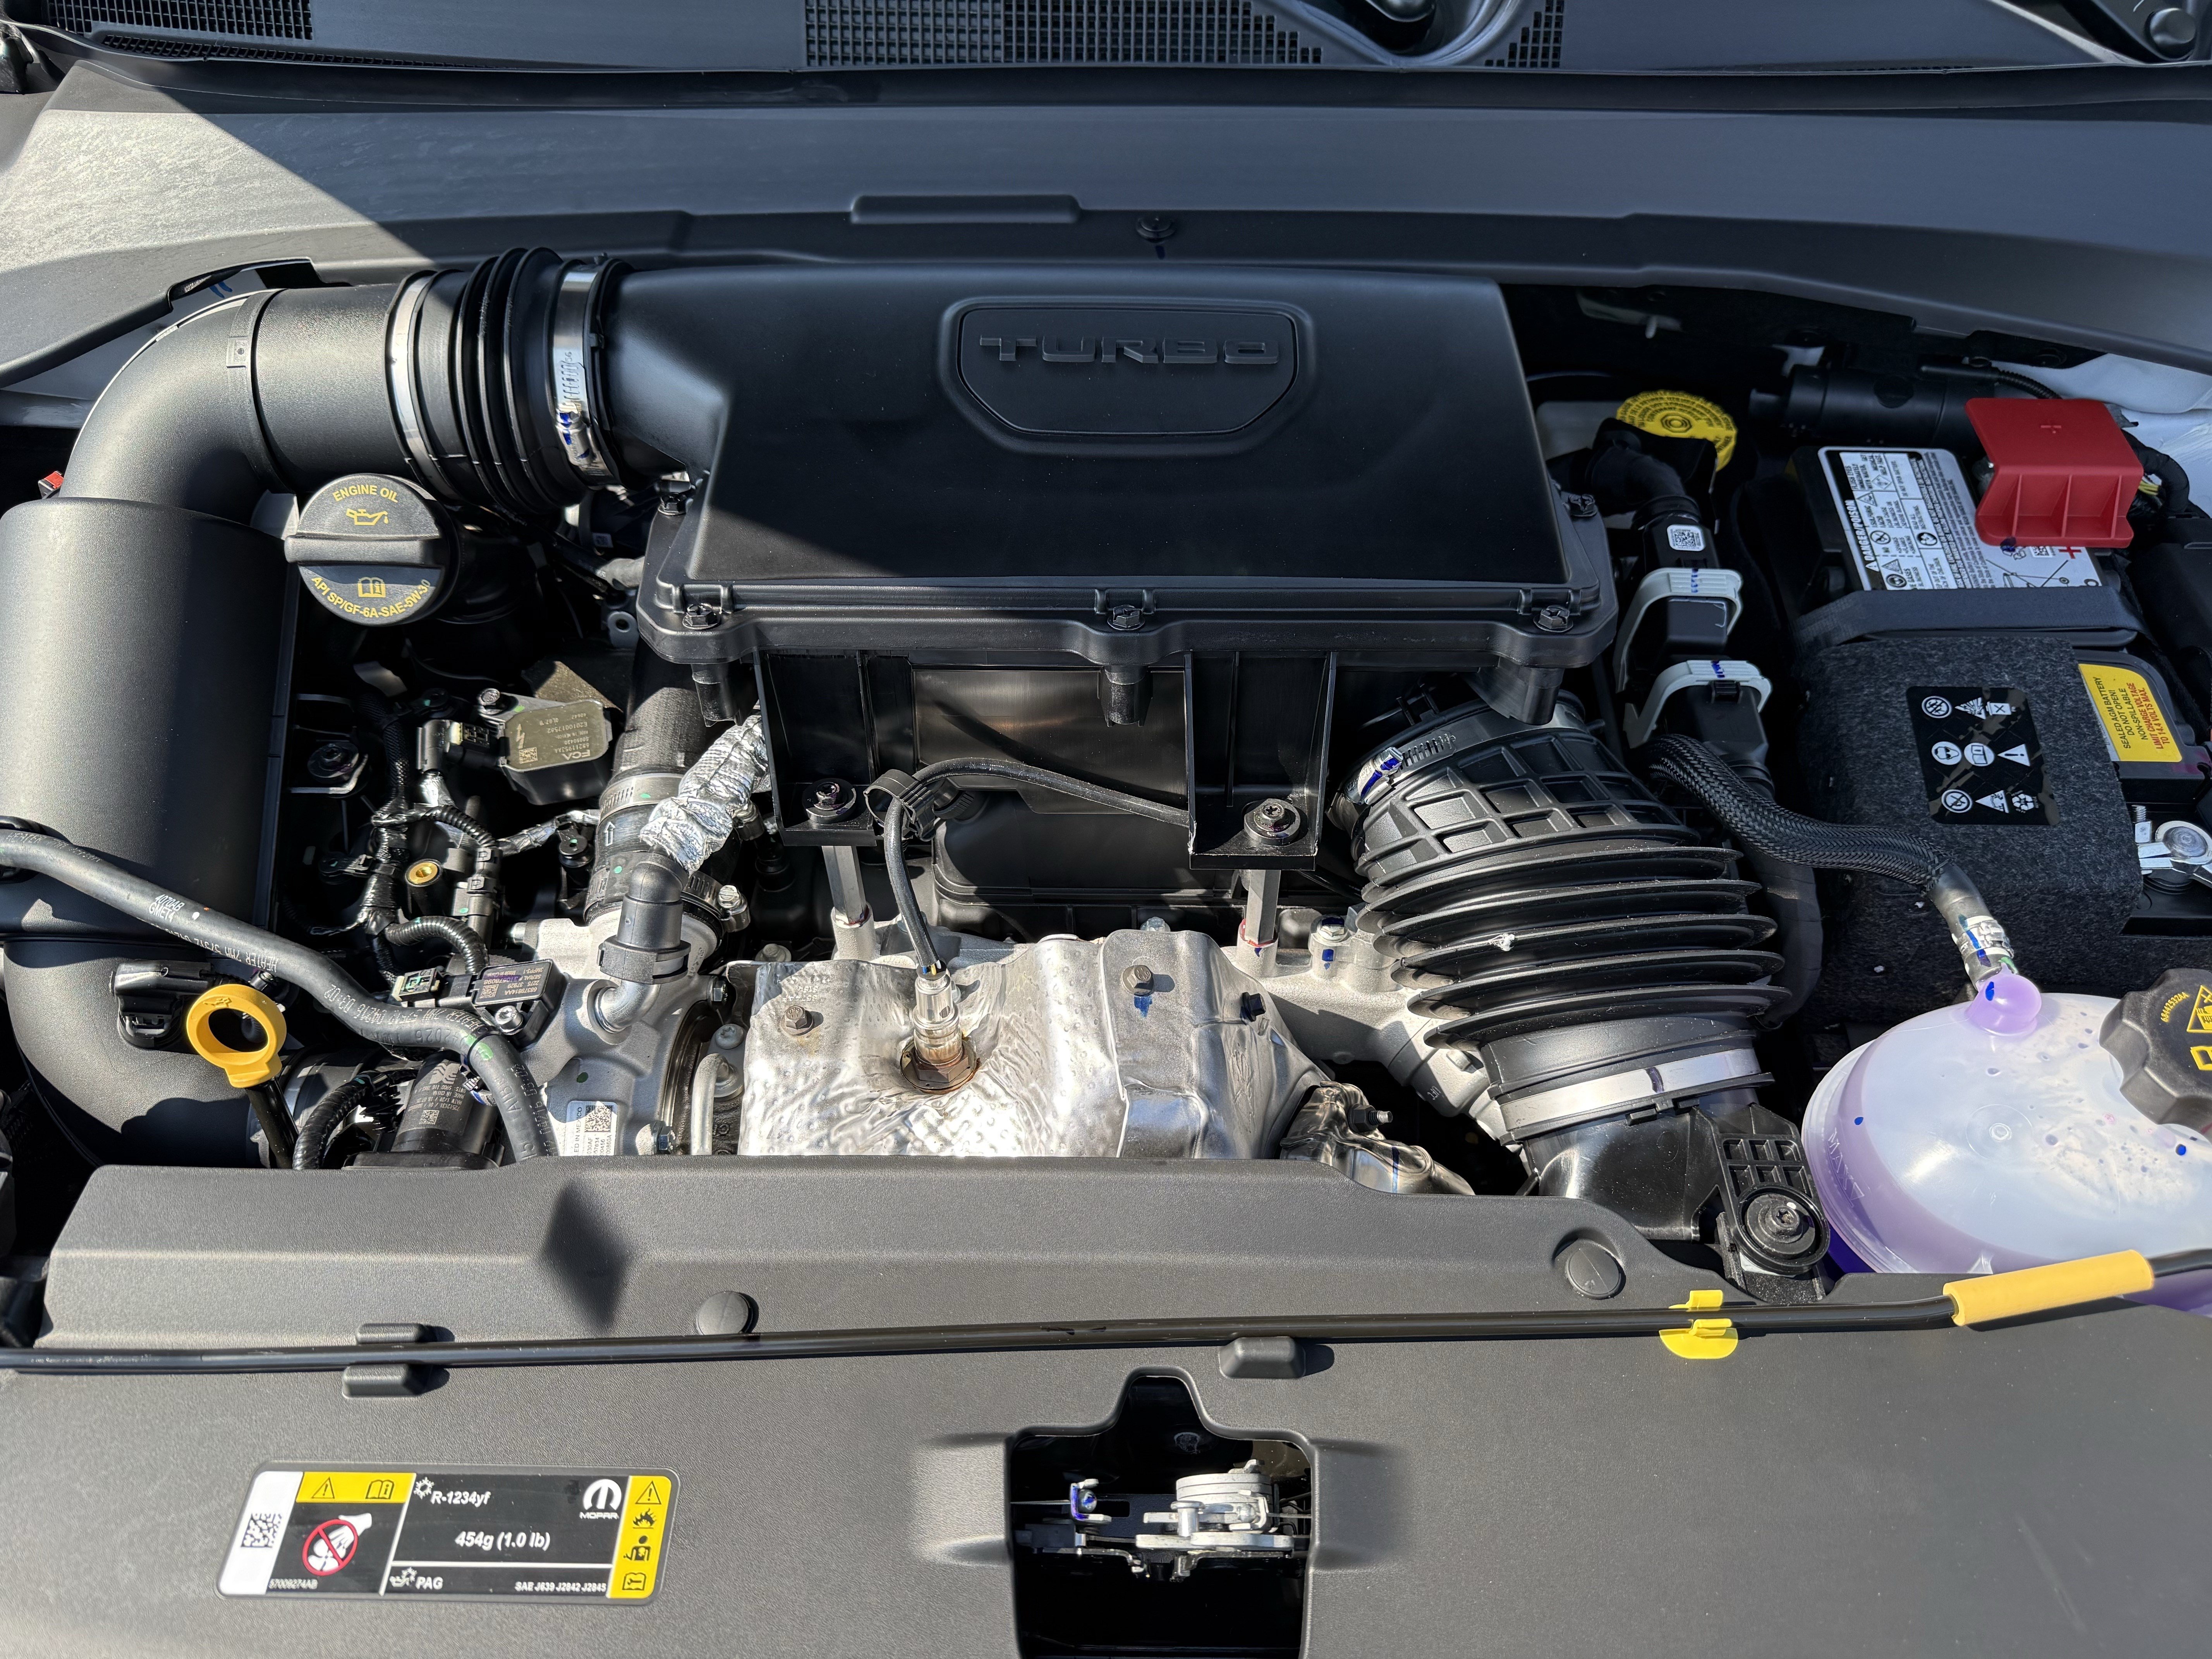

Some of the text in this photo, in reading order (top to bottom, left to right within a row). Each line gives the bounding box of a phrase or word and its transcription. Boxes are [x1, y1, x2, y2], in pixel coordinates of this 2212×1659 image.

[979, 334, 1279, 364] TURBO
[333, 485, 398, 503] ENGINE OIL
[1845, 499, 1875, 561] DANGER/POISON
[311, 577, 430, 618] API SP/GF-6A-SAE-5W-30
[2093, 676, 2111, 706] BATTERY
[2138, 687, 2151, 702] MAX.
[2107, 707, 2119, 721] AGM
[2108, 690, 2135, 735] DO NOT OPEN!
[2119, 688, 2148, 740] NON-SPILLABLE
[2126, 682, 2164, 749] LIMIT CHARGE VOLTAGE
[2145, 703, 2160, 721] VOLTS
[2114, 723, 2131, 749] SEALED
[2155, 723, 2166, 735] 14.4
[561, 749, 591, 761] FCA
[148, 902, 174, 922] GMET4
[155, 894, 185, 911] 4070AB
[246, 951, 279, 973] HEATER
[505, 987, 537, 995] 68379814AA
[2160, 991, 2190, 1023] 68442532AA
[445, 1010, 485, 1031] HEATER
[1828, 1127, 1854, 1190] MAX
[431, 1490, 491, 1506] R-1234yf
[455, 1532, 551, 1552] 454g (1.0 lb)
[416, 1577, 443, 1591] PAG
[515, 1581, 534, 1592] SAE
[555, 1582, 581, 1592] J2842
